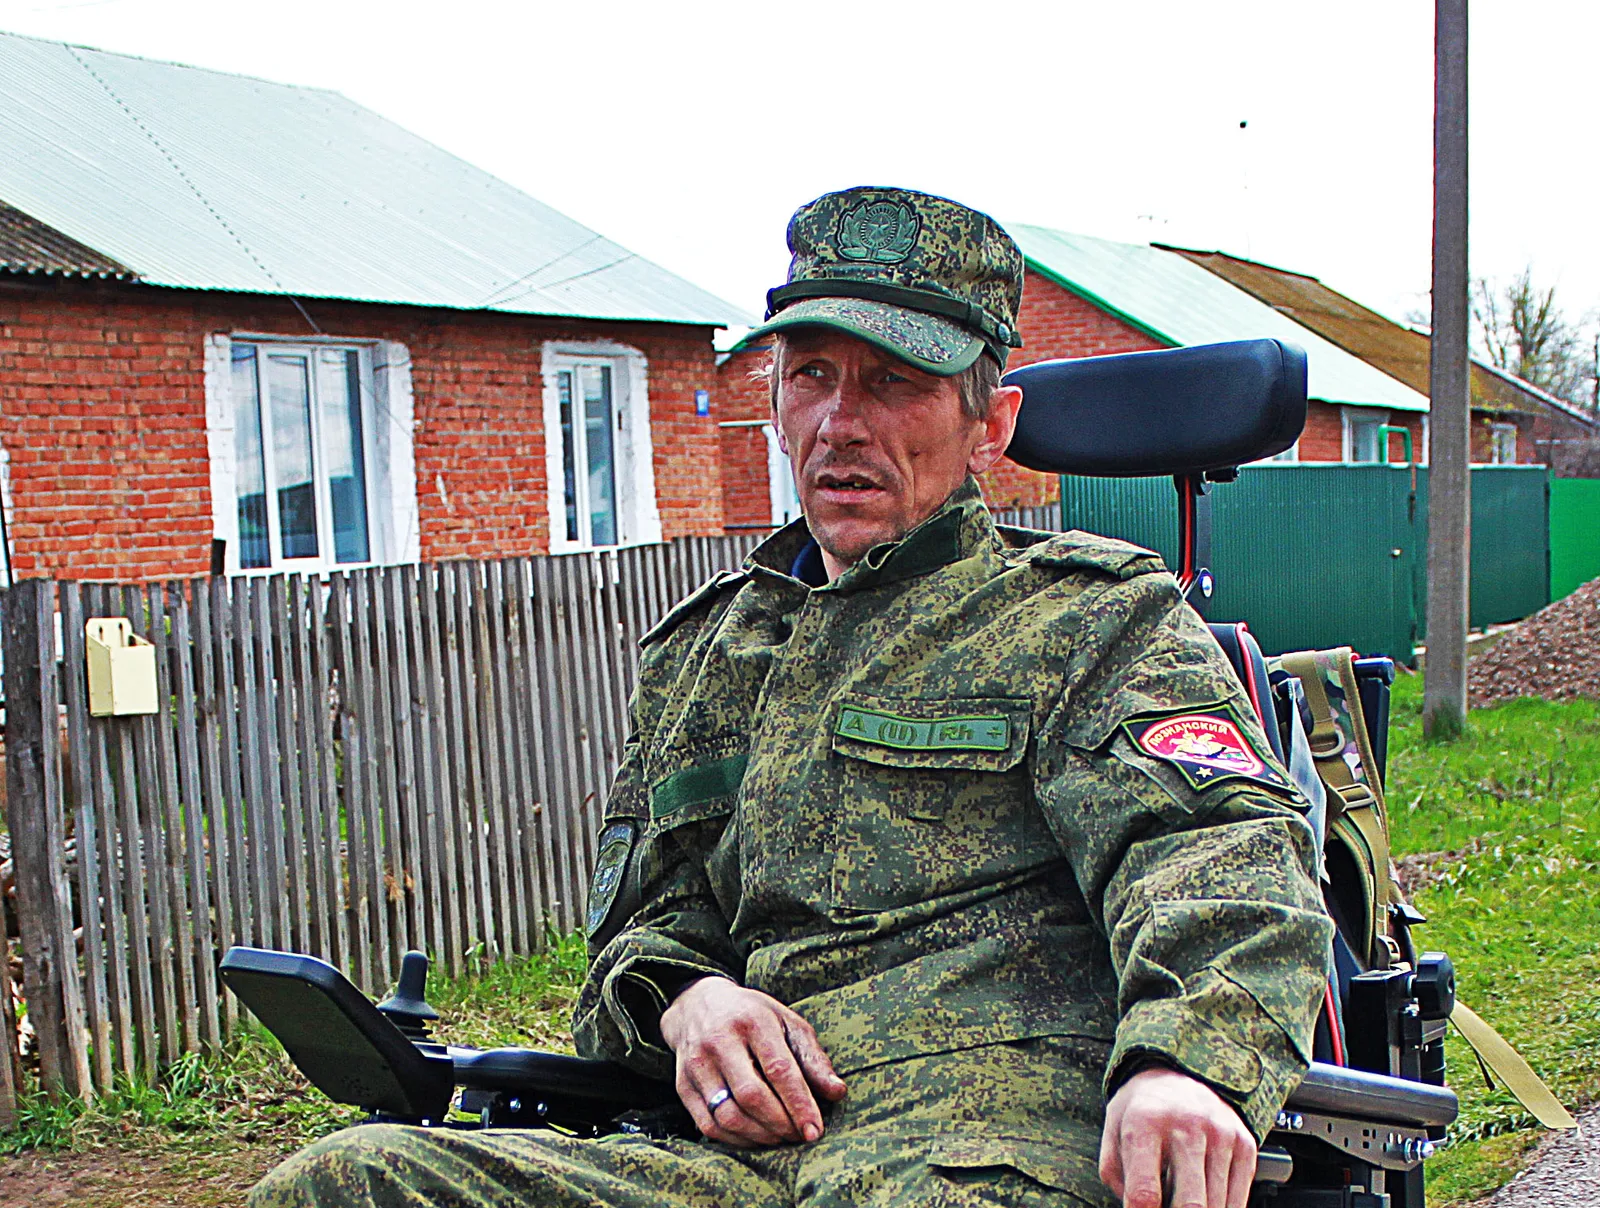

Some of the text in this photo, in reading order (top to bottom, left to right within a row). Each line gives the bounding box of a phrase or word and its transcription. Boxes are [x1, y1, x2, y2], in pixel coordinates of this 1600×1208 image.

[845, 715, 867, 734] A
[939, 724, 975, 742] Rh
[1148, 722, 1228, 746] ПОЗНАНСКИЙ
